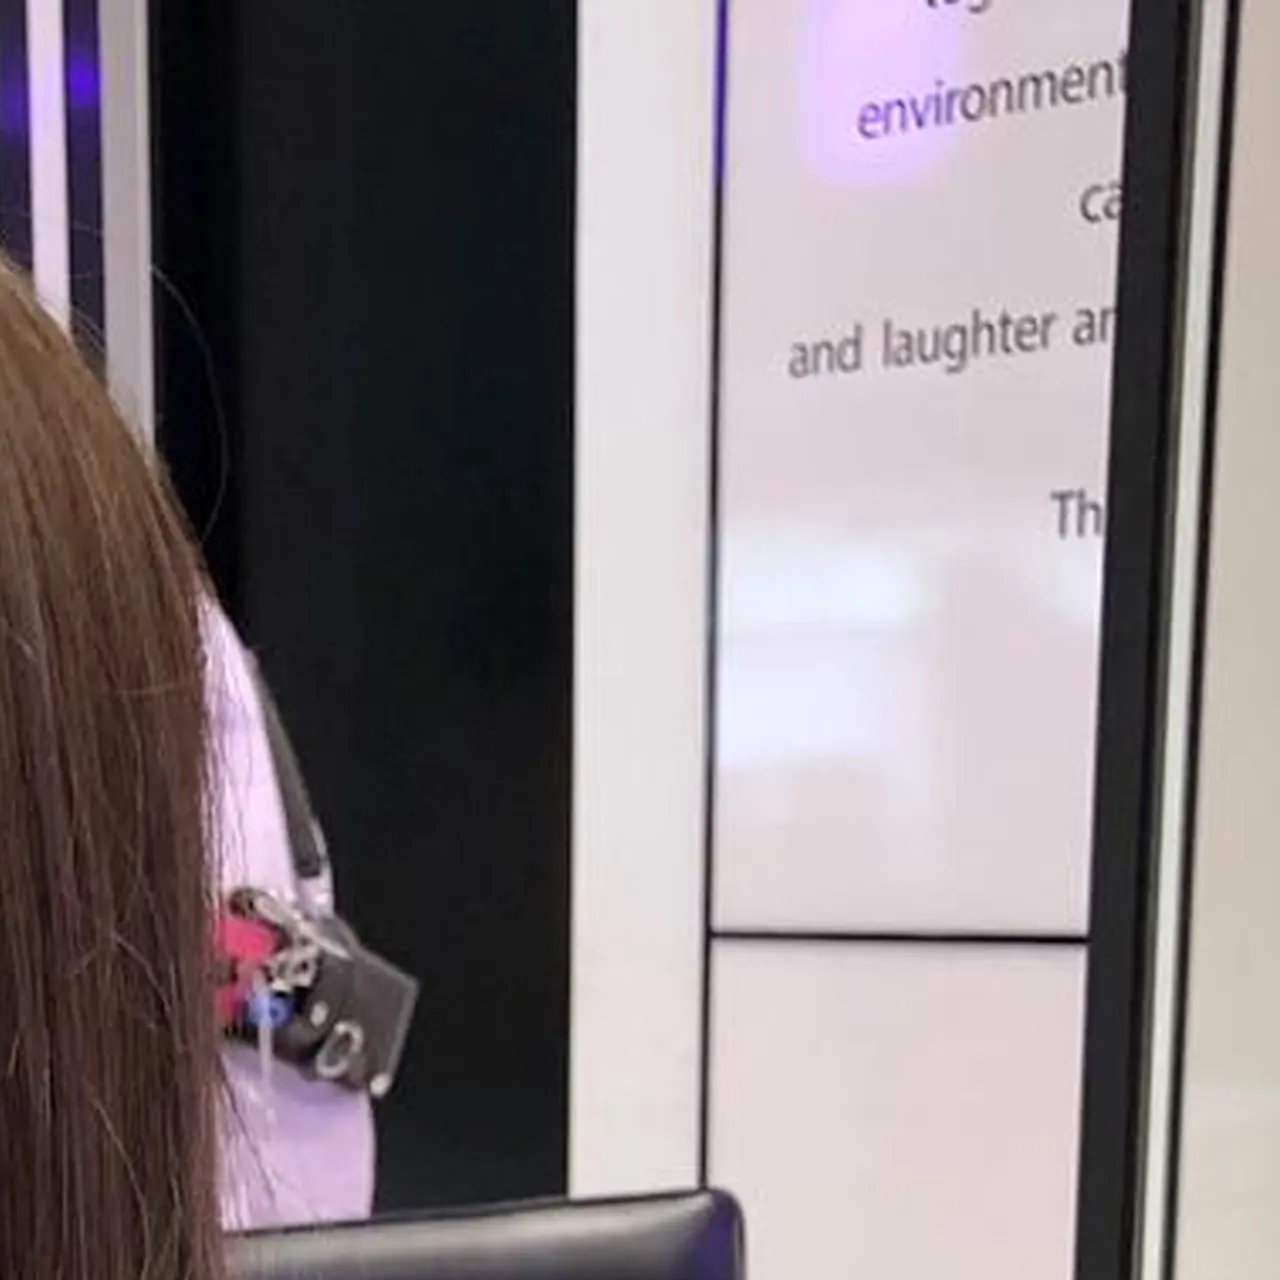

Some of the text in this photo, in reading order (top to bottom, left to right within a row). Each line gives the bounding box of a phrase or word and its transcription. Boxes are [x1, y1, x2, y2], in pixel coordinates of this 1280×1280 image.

[788, 321, 864, 380] and
[882, 307, 1058, 376] laughter
[1049, 487, 1103, 541] Th
